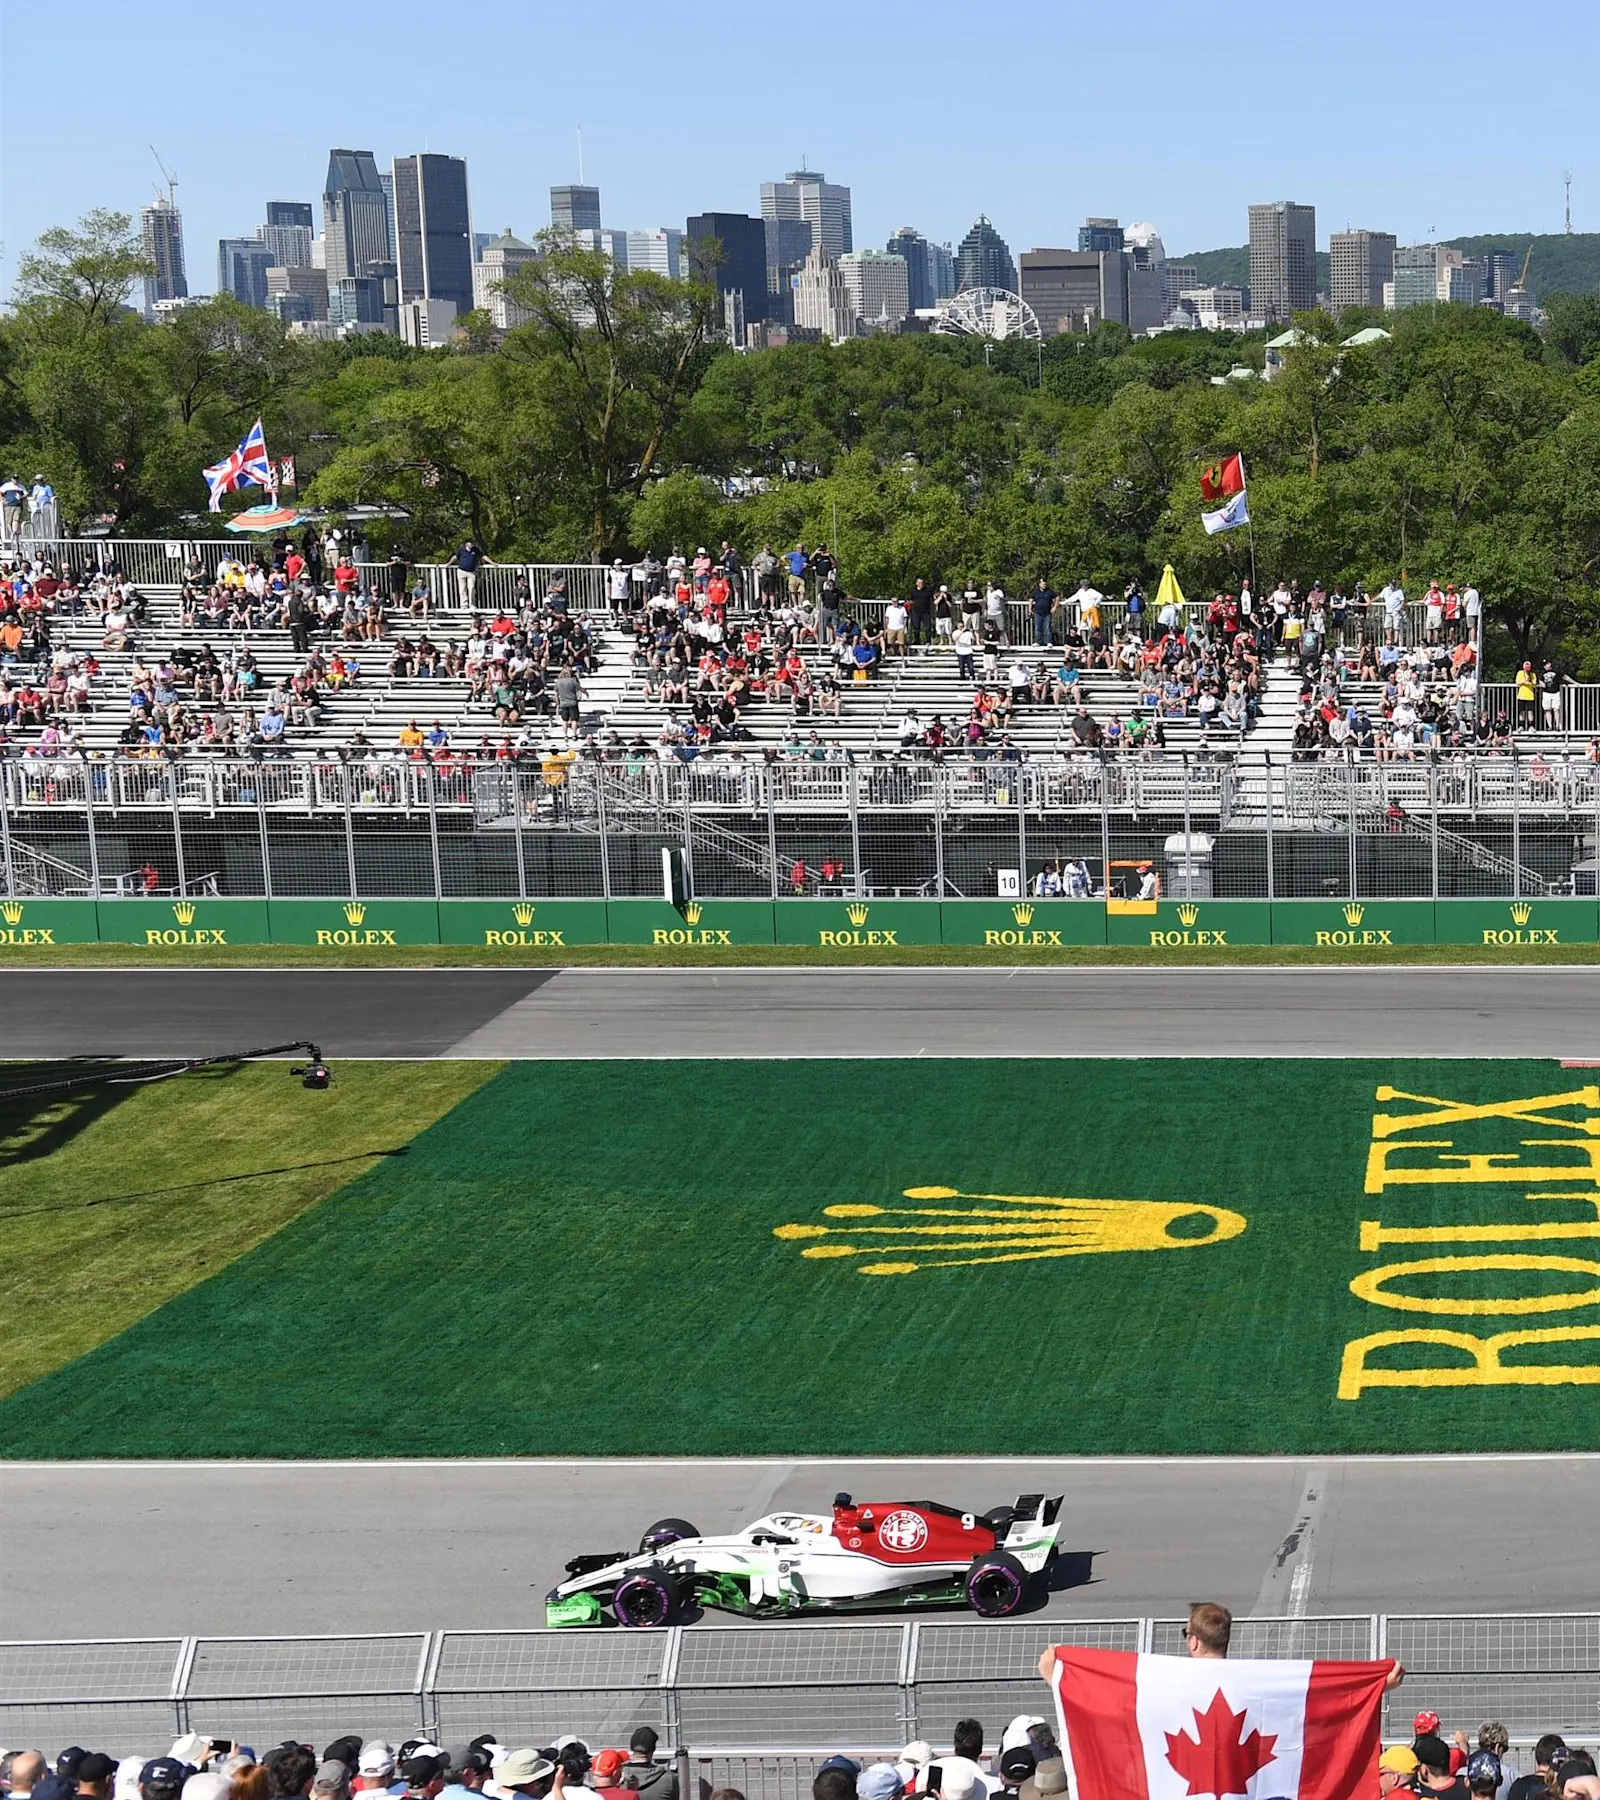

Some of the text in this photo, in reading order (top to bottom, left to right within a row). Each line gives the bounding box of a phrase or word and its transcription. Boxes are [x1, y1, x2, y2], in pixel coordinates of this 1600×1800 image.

[170, 544, 177, 556] 7
[1001, 877, 1016, 890] 10
[146, 929, 224, 945] ROLEX
[317, 931, 396, 947] ROLEX
[486, 931, 563, 947] ROLEX
[653, 930, 730, 946] ROLEX
[820, 931, 897, 947] ROLEX
[985, 931, 1061, 947] ROLEX
[1150, 931, 1228, 947] ROLEX
[1316, 930, 1392, 946] ROLEX
[1482, 930, 1557, 946] ROLEX
[881, 1511, 926, 1536] ALFA ROMEO
[961, 1513, 976, 1530] 9
